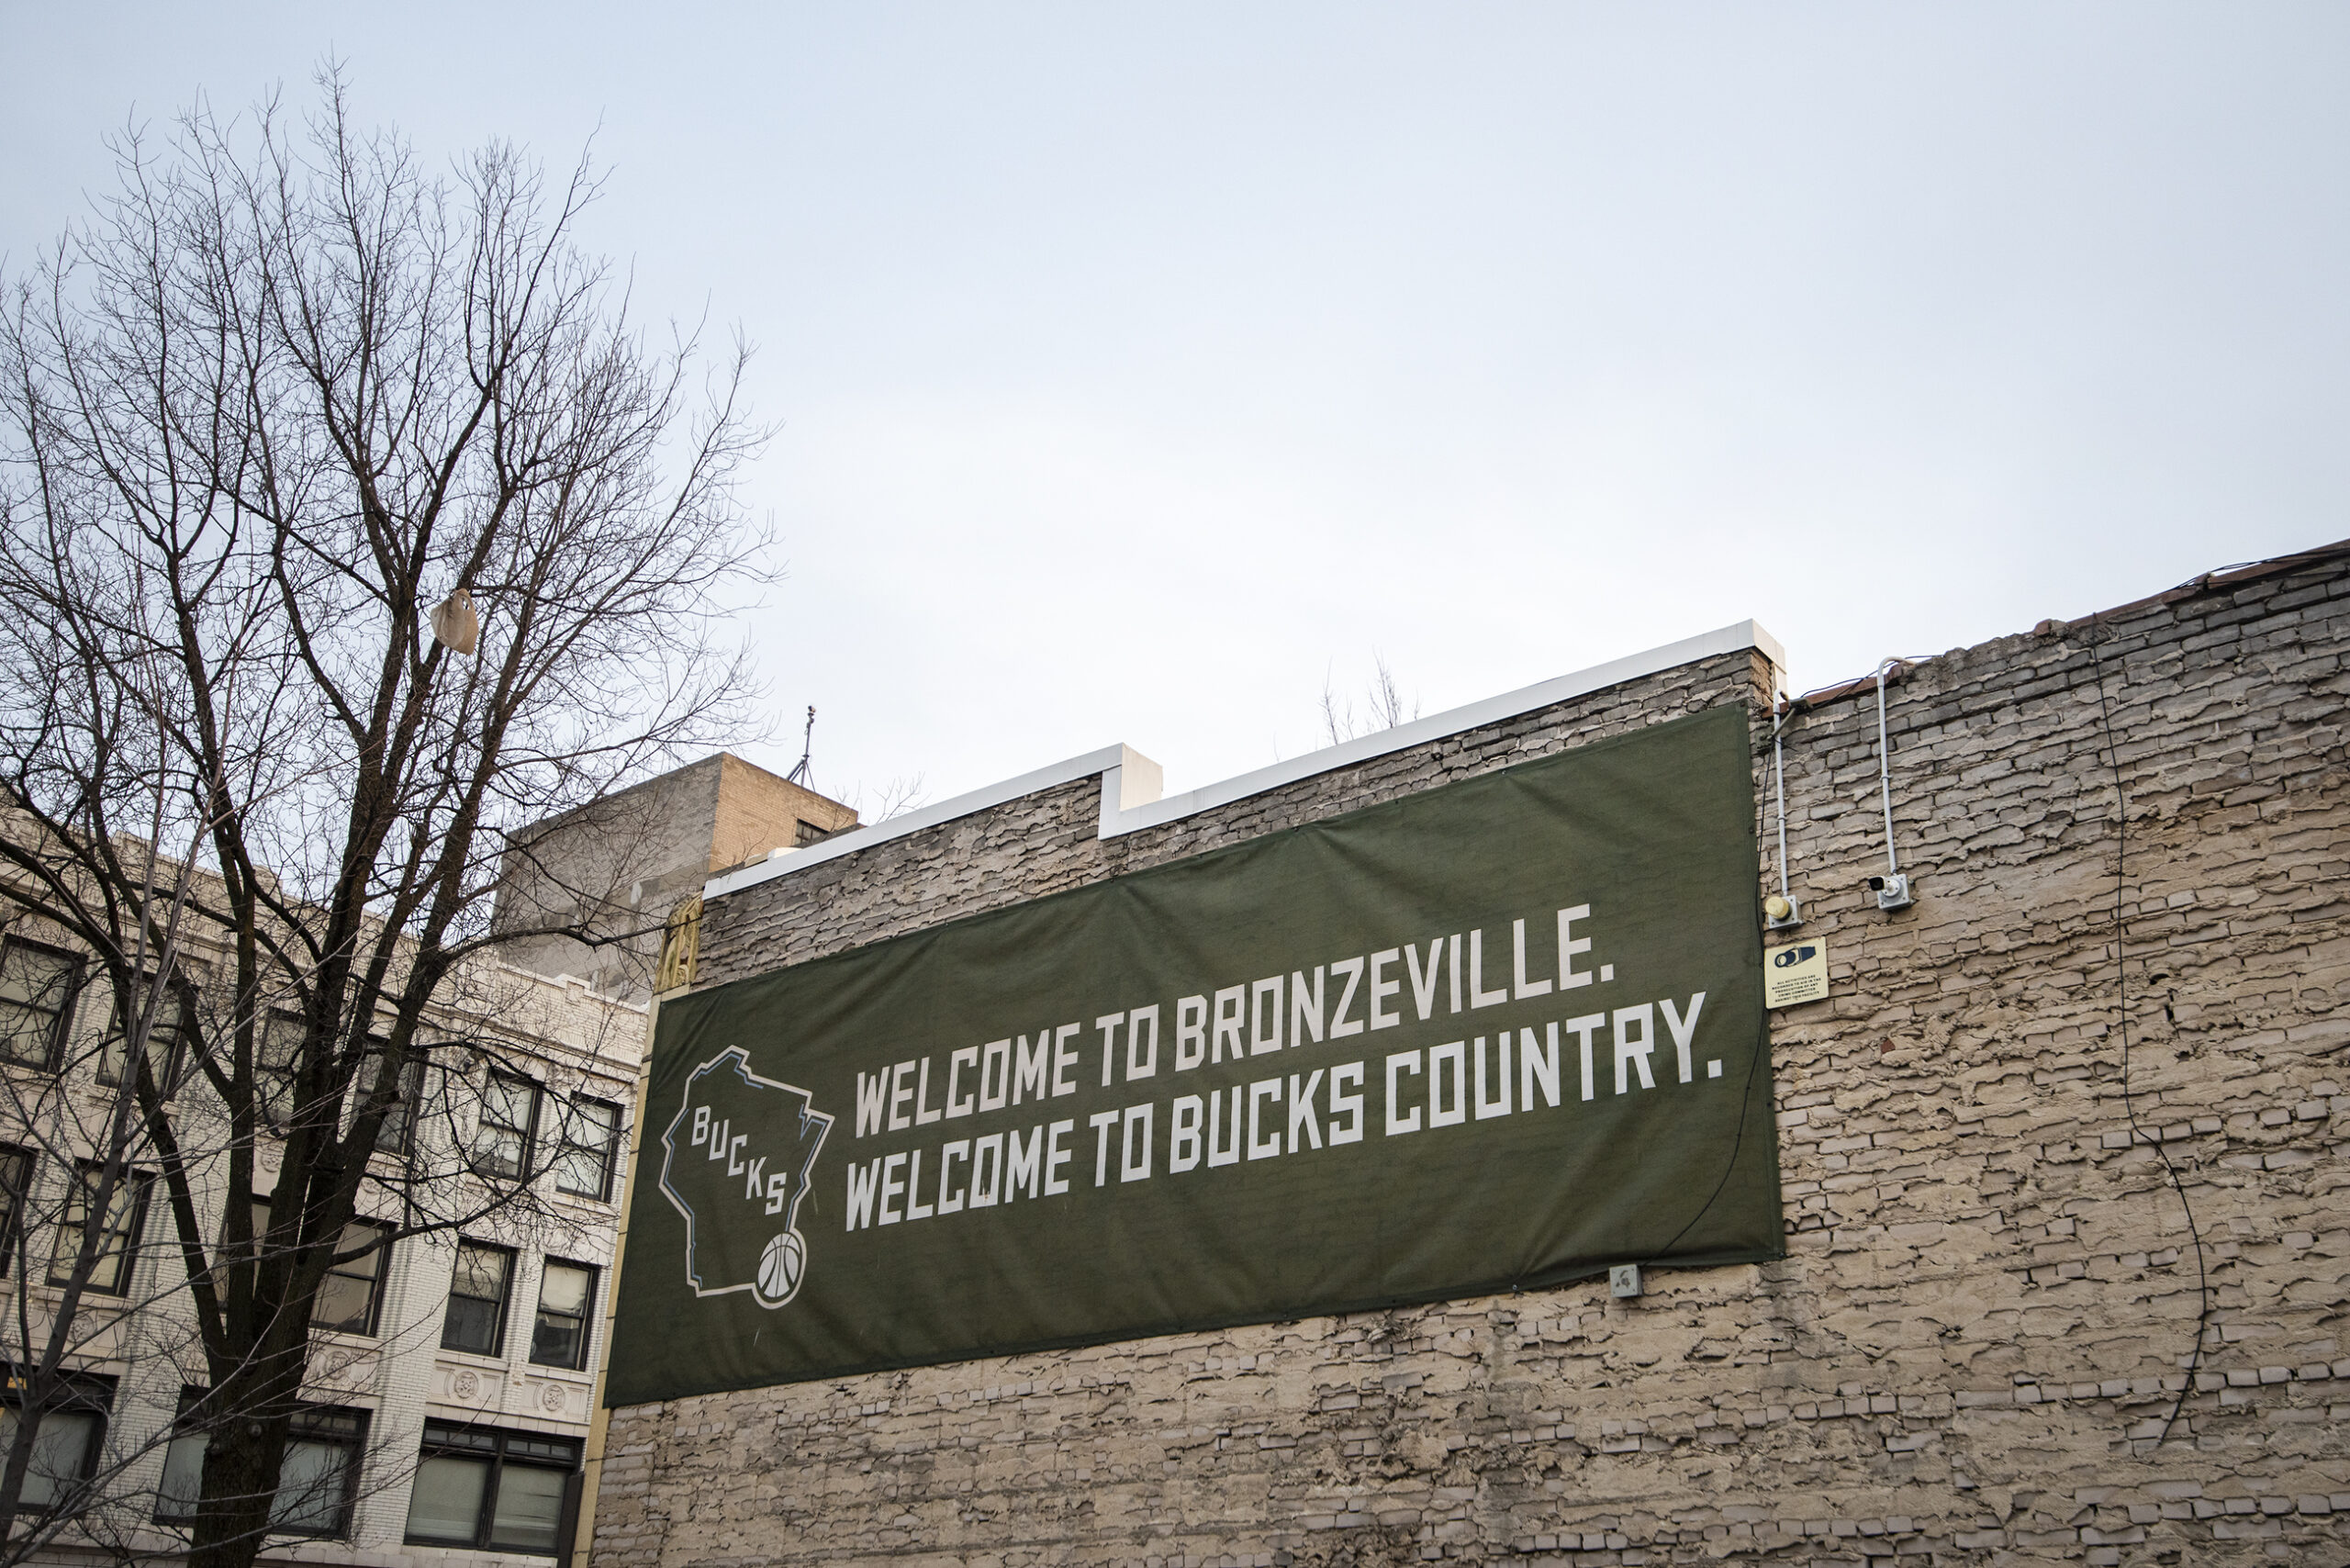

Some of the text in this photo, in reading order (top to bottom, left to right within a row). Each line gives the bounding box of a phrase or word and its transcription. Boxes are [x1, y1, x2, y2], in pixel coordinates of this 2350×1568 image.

[846, 991, 1721, 1231] WELCOME TO BUCKS COUNTRY.
[856, 903, 1614, 1138] WELCOME TO BRONZEVILLE.
[691, 1105, 787, 1215] BUCKS
